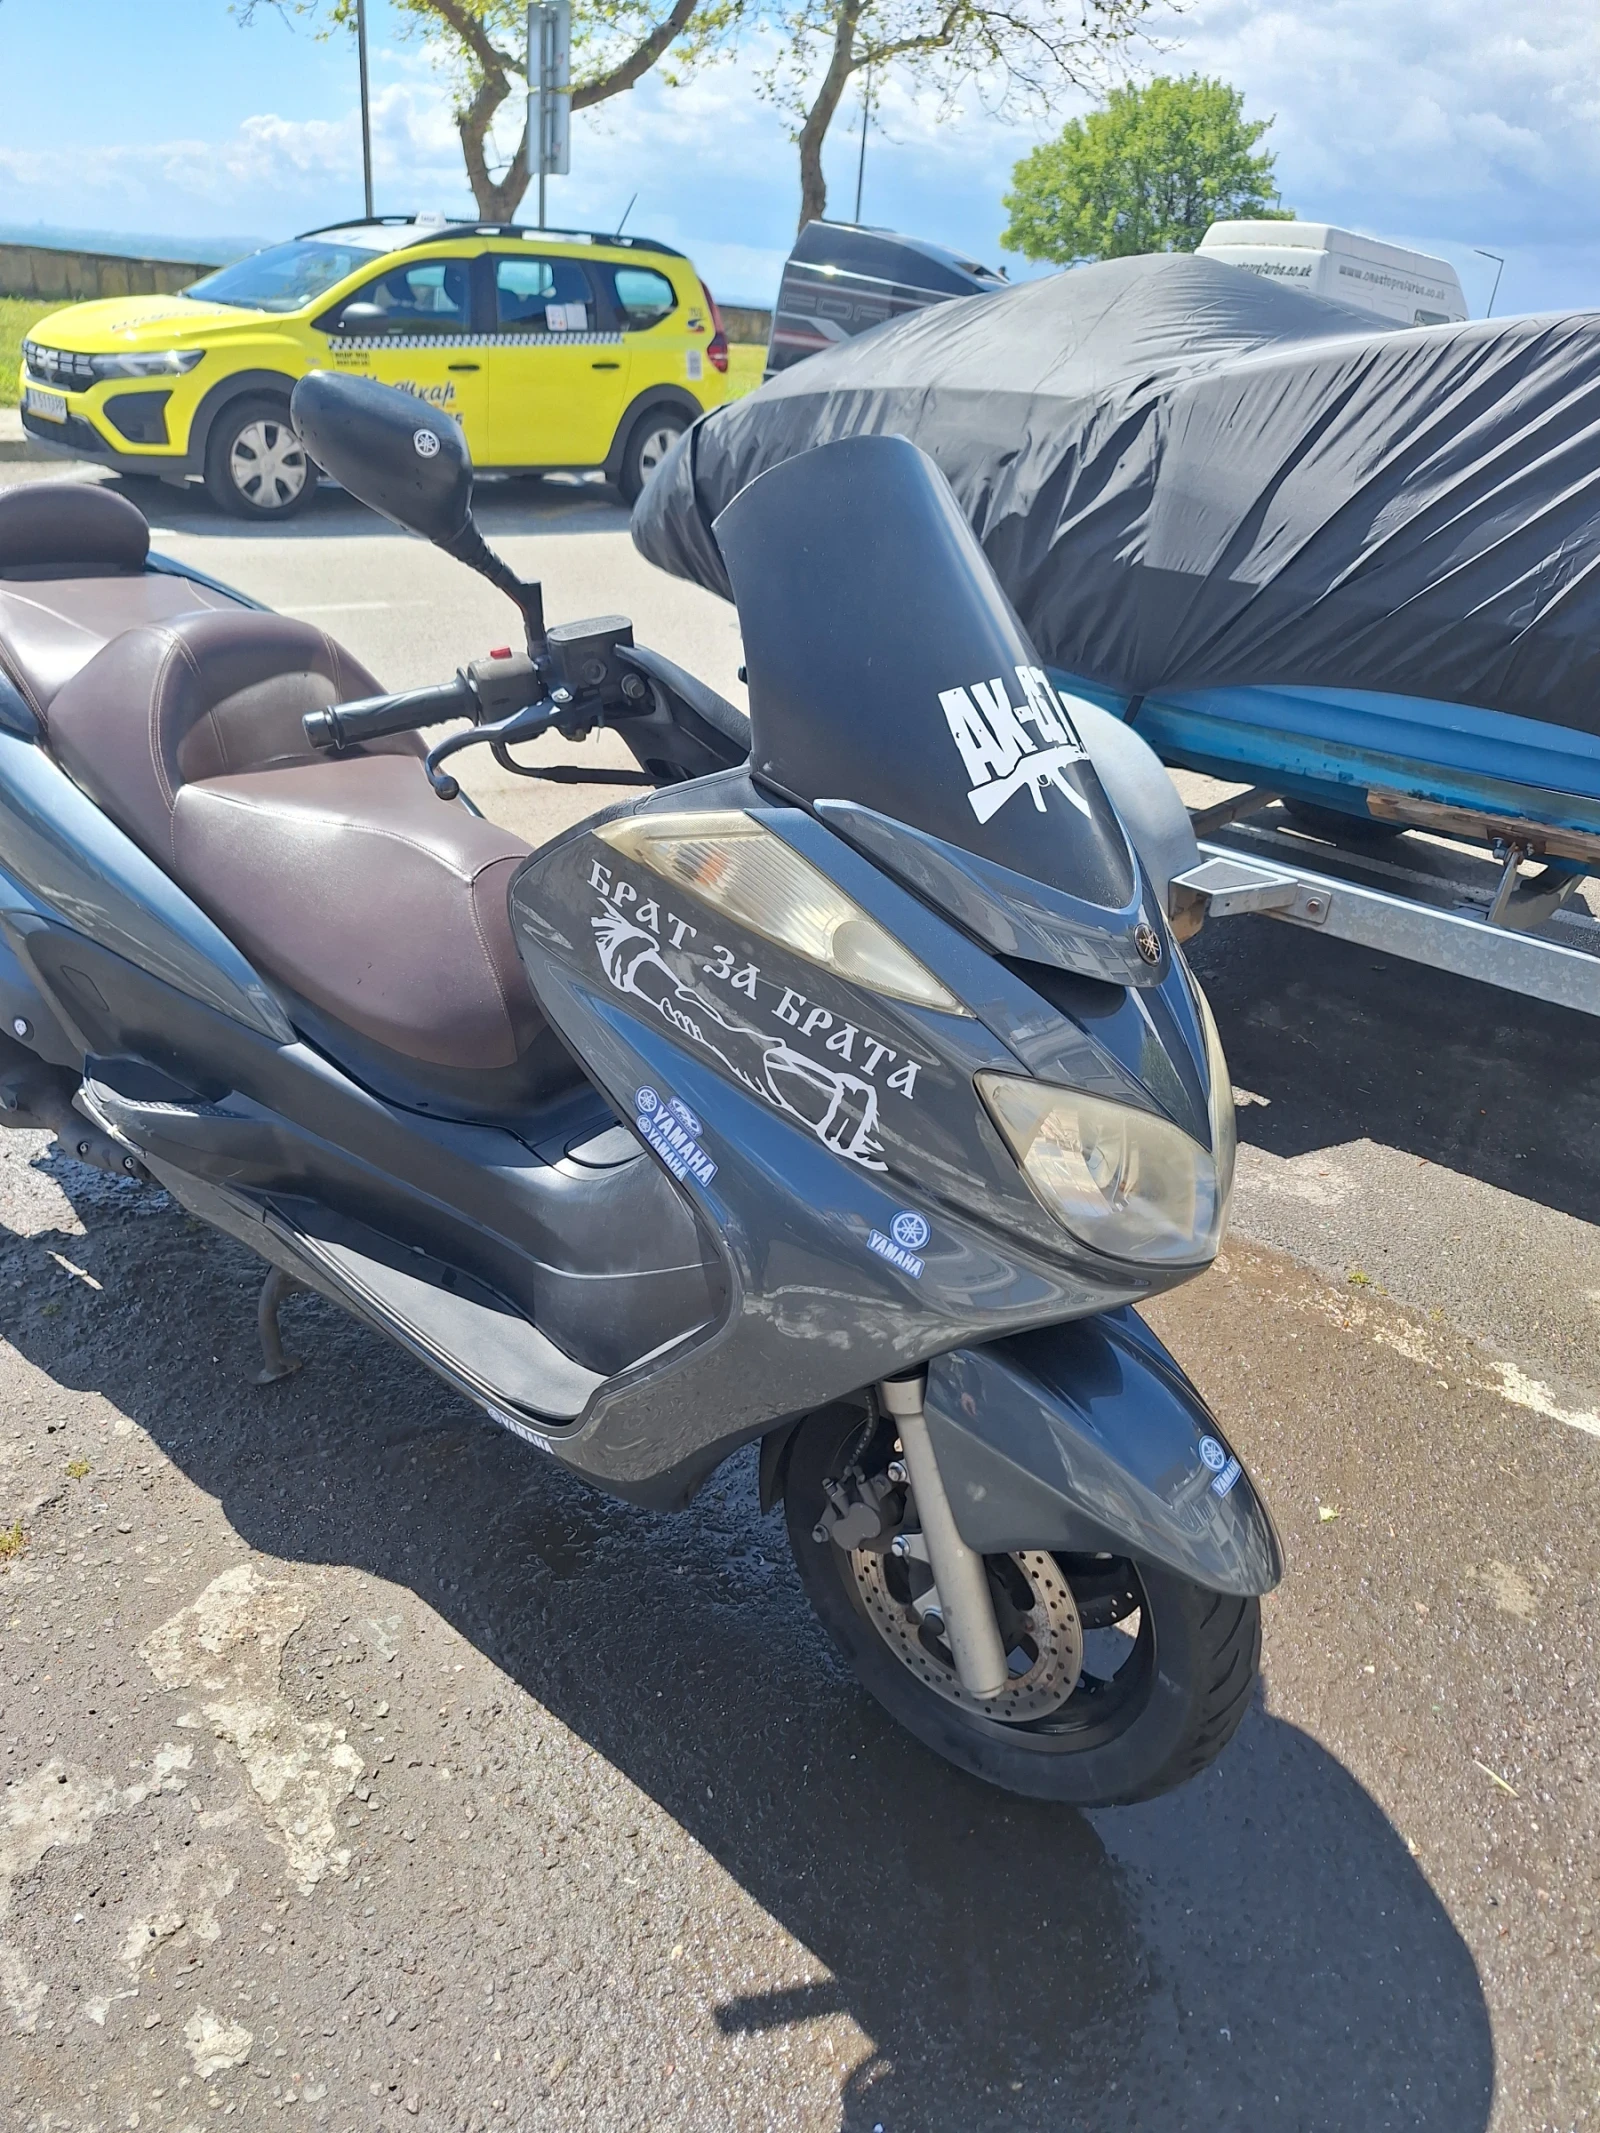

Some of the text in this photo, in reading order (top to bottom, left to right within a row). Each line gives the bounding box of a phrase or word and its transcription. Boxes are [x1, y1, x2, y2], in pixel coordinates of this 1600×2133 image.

[782, 292, 900, 323] FOR
[937, 665, 1079, 787] AK-47
[587, 859, 922, 1100] БРАТ ЗА БРАТА
[647, 1127, 688, 1179] YAMAHA
[653, 1105, 715, 1183] YAMAHA
[870, 1233, 922, 1276] YAMAHA
